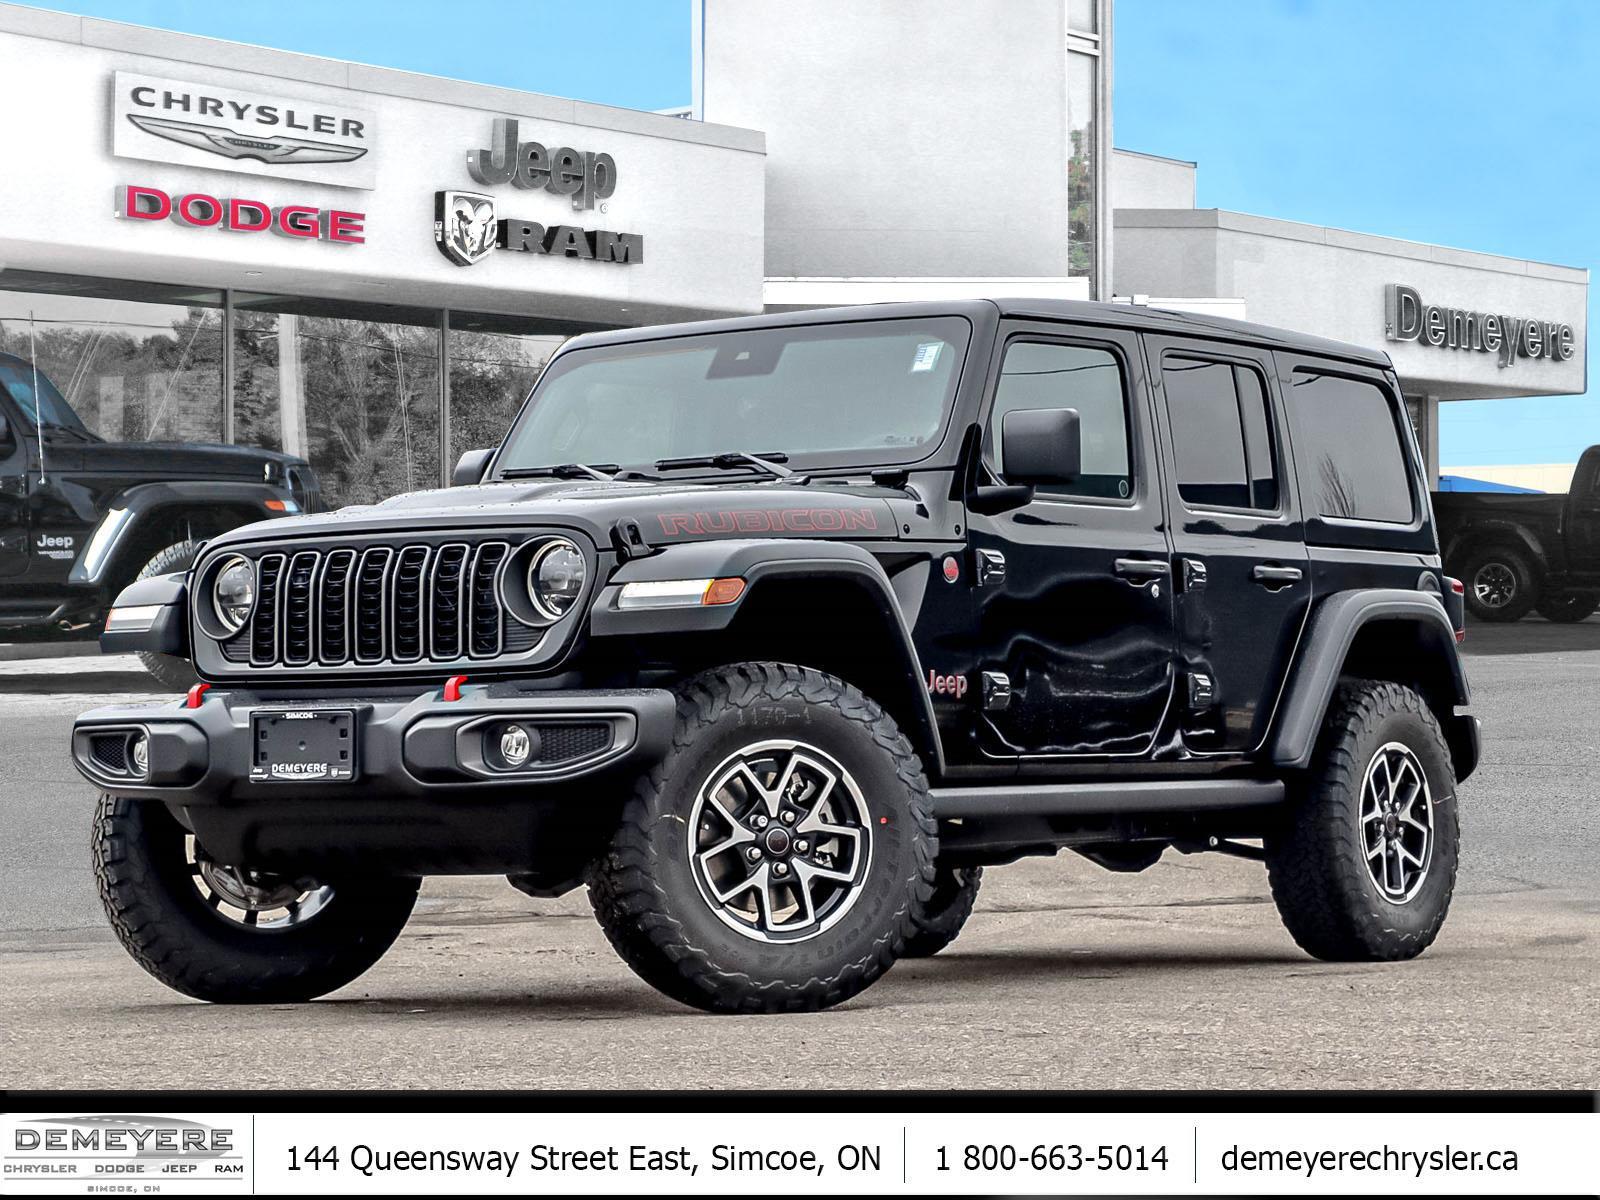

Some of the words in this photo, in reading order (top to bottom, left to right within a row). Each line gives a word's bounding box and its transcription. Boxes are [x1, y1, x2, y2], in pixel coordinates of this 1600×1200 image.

[130, 86, 365, 139] CHRYSLER
[467, 118, 617, 210] Jeep
[117, 184, 366, 244] DODGE
[497, 219, 643, 265] RAM
[1386, 283, 1575, 368] Demeyere
[37, 534, 74, 549] Jeep
[657, 508, 878, 535] RUBICON
[928, 669, 968, 699] Jeep
[271, 763, 328, 774] DEMEYERE
